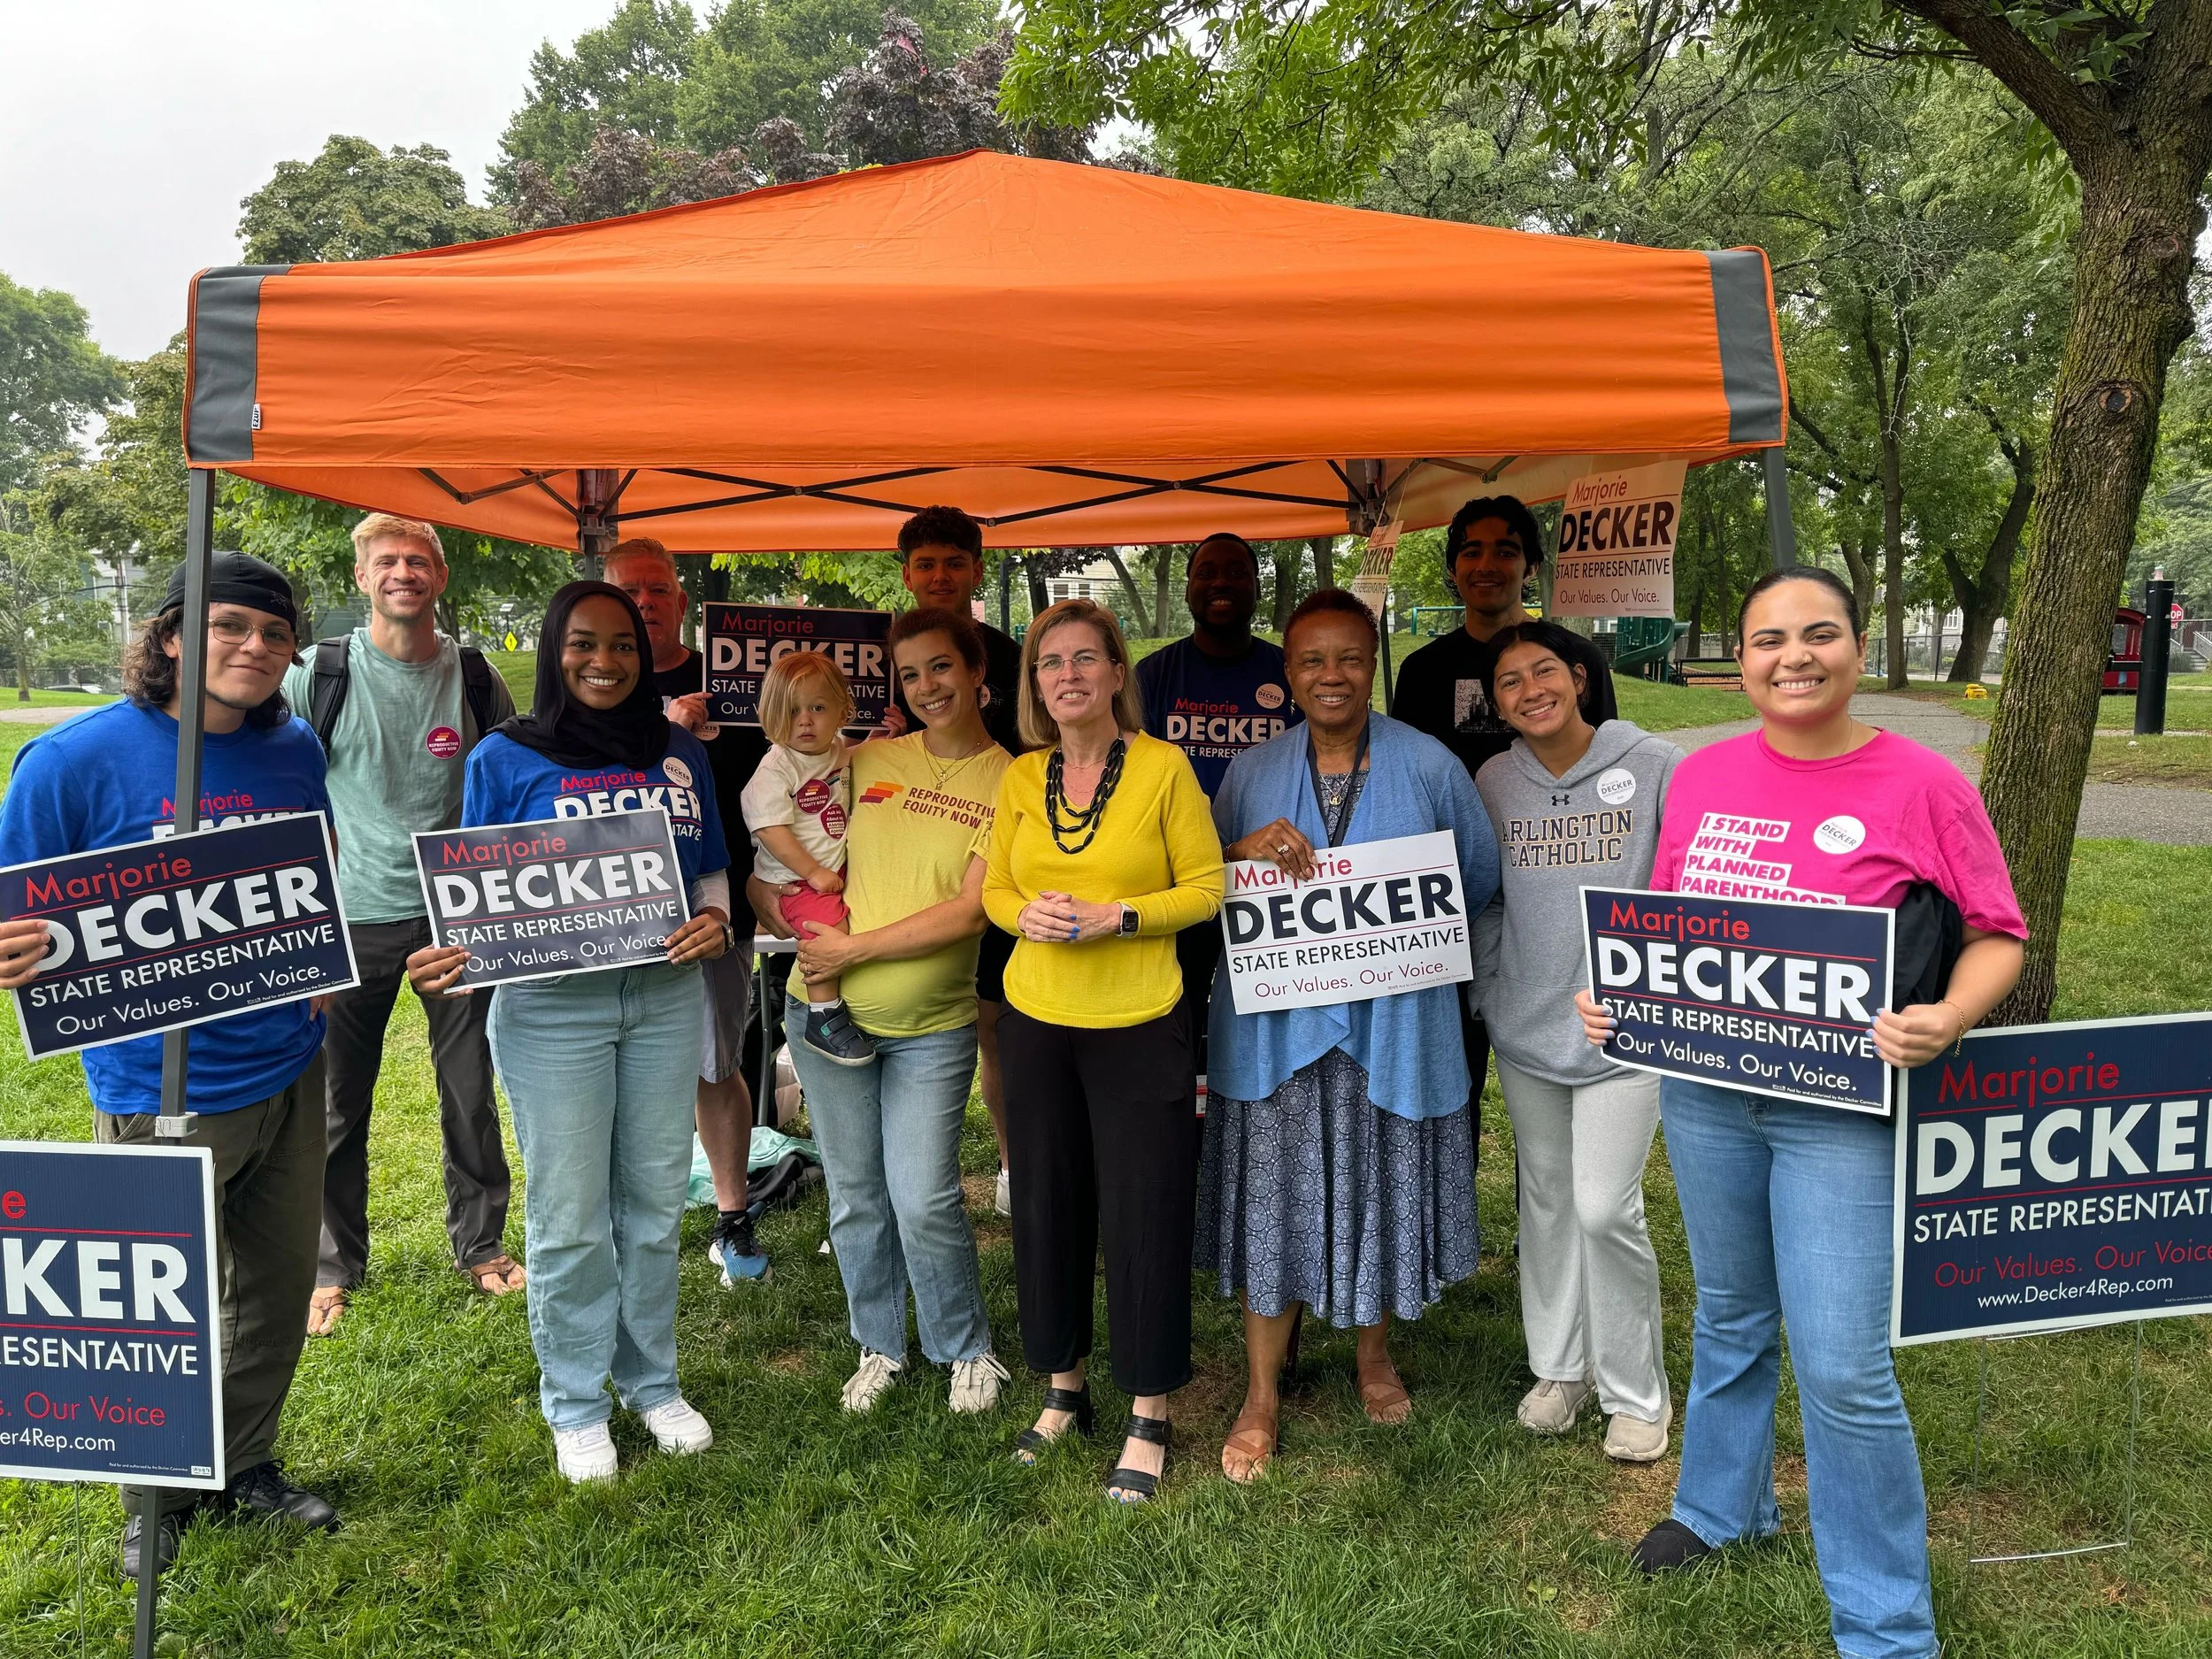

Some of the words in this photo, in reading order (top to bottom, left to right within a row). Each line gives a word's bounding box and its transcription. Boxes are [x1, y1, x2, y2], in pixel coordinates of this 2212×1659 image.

[1571, 474, 1628, 506] Marjorie
[1558, 501, 1674, 554] DECKER
[1555, 563, 1578, 580] STATE
[1582, 557, 1670, 579] REPRESENTATIVE
[1560, 590, 1575, 603] Our
[1578, 589, 1609, 603] Values.
[1611, 588, 1630, 603] Our
[1632, 588, 1660, 603] Voice.
[722, 611, 814, 638] Marjorie
[2170, 611, 2182, 619] OP
[711, 680, 756, 694] STATE
[721, 702, 749, 715] Our
[1175, 697, 1239, 715] Marjorie
[1166, 715, 1286, 743] DECKER
[561, 768, 647, 793] Marjorie
[1601, 780, 1633, 795] DECKER
[162, 789, 253, 817] Mrjorie
[553, 787, 703, 822] DECKER
[902, 800, 949, 818] EQUITY
[950, 810, 982, 830] NOW
[1702, 816, 1711, 830] I
[1712, 818, 1785, 839] STAND
[1822, 825, 1857, 847] DECKER
[443, 832, 566, 867] Marjorie
[1509, 837, 1623, 867] CATHOLIC
[1695, 835, 1752, 856] WITH
[27, 853, 193, 908] Marjorie
[434, 851, 672, 918] DECKER
[1687, 855, 1786, 881] PLANNED
[19, 866, 329, 972] DECKER
[447, 924, 508, 948] STATE
[513, 900, 678, 938] REPRESENTATIVE
[1225, 872, 1461, 945] DECKER
[1610, 899, 1750, 942] Marjorie
[30, 973, 113, 1008] STATE
[120, 924, 336, 991] REPRESENTATIVE
[466, 955, 505, 973] Our
[508, 948, 574, 970] Values.
[580, 940, 616, 958] Our
[1233, 950, 1288, 973] STATE
[1296, 926, 1464, 966] REPRESENTATIVE
[1255, 982, 1288, 998] Our
[1292, 975, 1354, 994] Values.
[1359, 969, 1393, 985] Our
[1398, 961, 1449, 979] Voice.
[1596, 936, 1873, 1023] DECKER
[56, 1013, 107, 1036] Our
[112, 995, 200, 1024] Values.
[207, 980, 255, 1002] Our
[259, 965, 326, 989] Voice.
[1601, 997, 1663, 1026] STATE
[1672, 1007, 1874, 1059] REPRESENTATIVE
[1617, 1032, 1655, 1055] Our
[1660, 1039, 1732, 1071] Values.
[1740, 1054, 1782, 1079] Our
[1789, 1062, 1858, 1091] Voice.
[1938, 1051, 2120, 1109] Marjorie
[1916, 1099, 2212, 1196] DECKE
[1914, 1207, 1999, 1244] STATE
[2010, 1187, 2212, 1233] REPRESENTAT
[3, 1238, 196, 1324] KER
[1935, 1262, 1986, 1288] Our
[1993, 1252, 2083, 1280] Values.
[2095, 1245, 2147, 1271] Our
[1978, 1276, 2174, 1309] www.Decker4Rep.com
[1, 1336, 198, 1375] ESENTATIVE
[25, 1391, 81, 1421] Our
[89, 1394, 165, 1426] Voice
[0, 1426, 116, 1453] er4Rep.com
